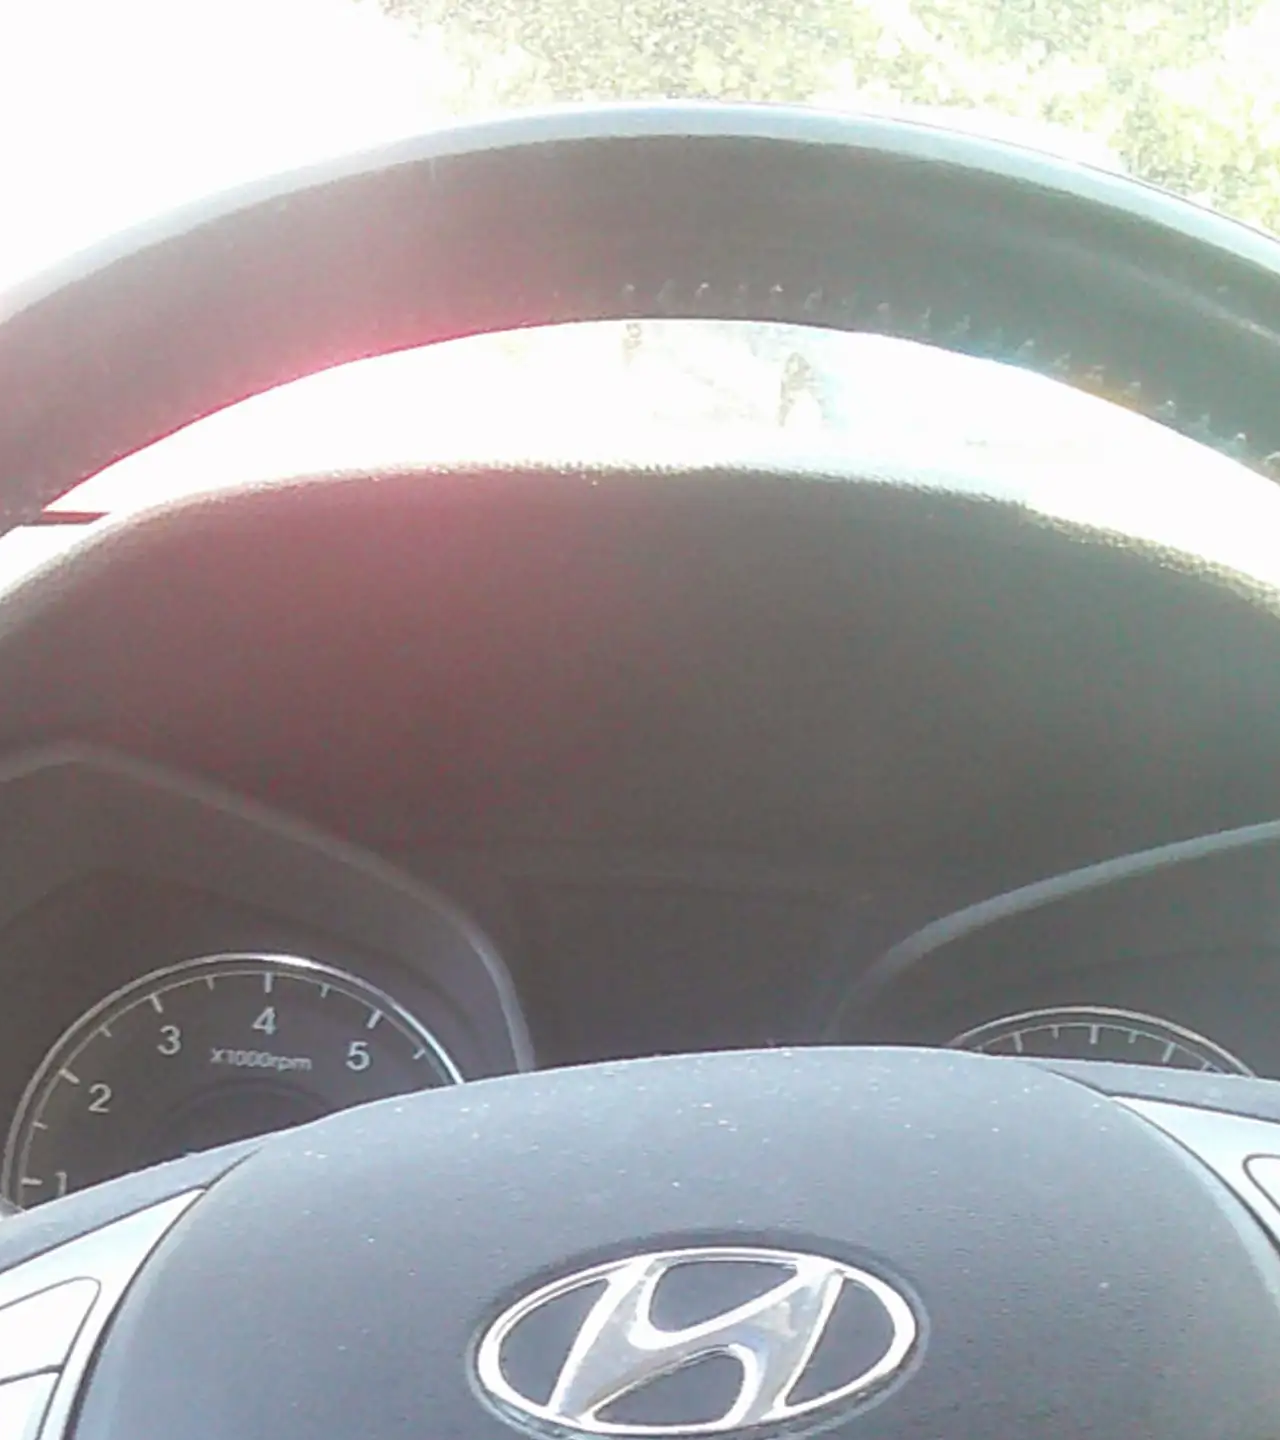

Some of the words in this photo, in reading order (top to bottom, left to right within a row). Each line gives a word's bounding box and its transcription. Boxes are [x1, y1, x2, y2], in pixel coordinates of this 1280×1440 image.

[252, 1006, 277, 1036] 4
[157, 1025, 182, 1056] 3
[346, 1041, 371, 1071] 5
[88, 1083, 112, 1113] 2
[55, 1171, 68, 1197] 1
